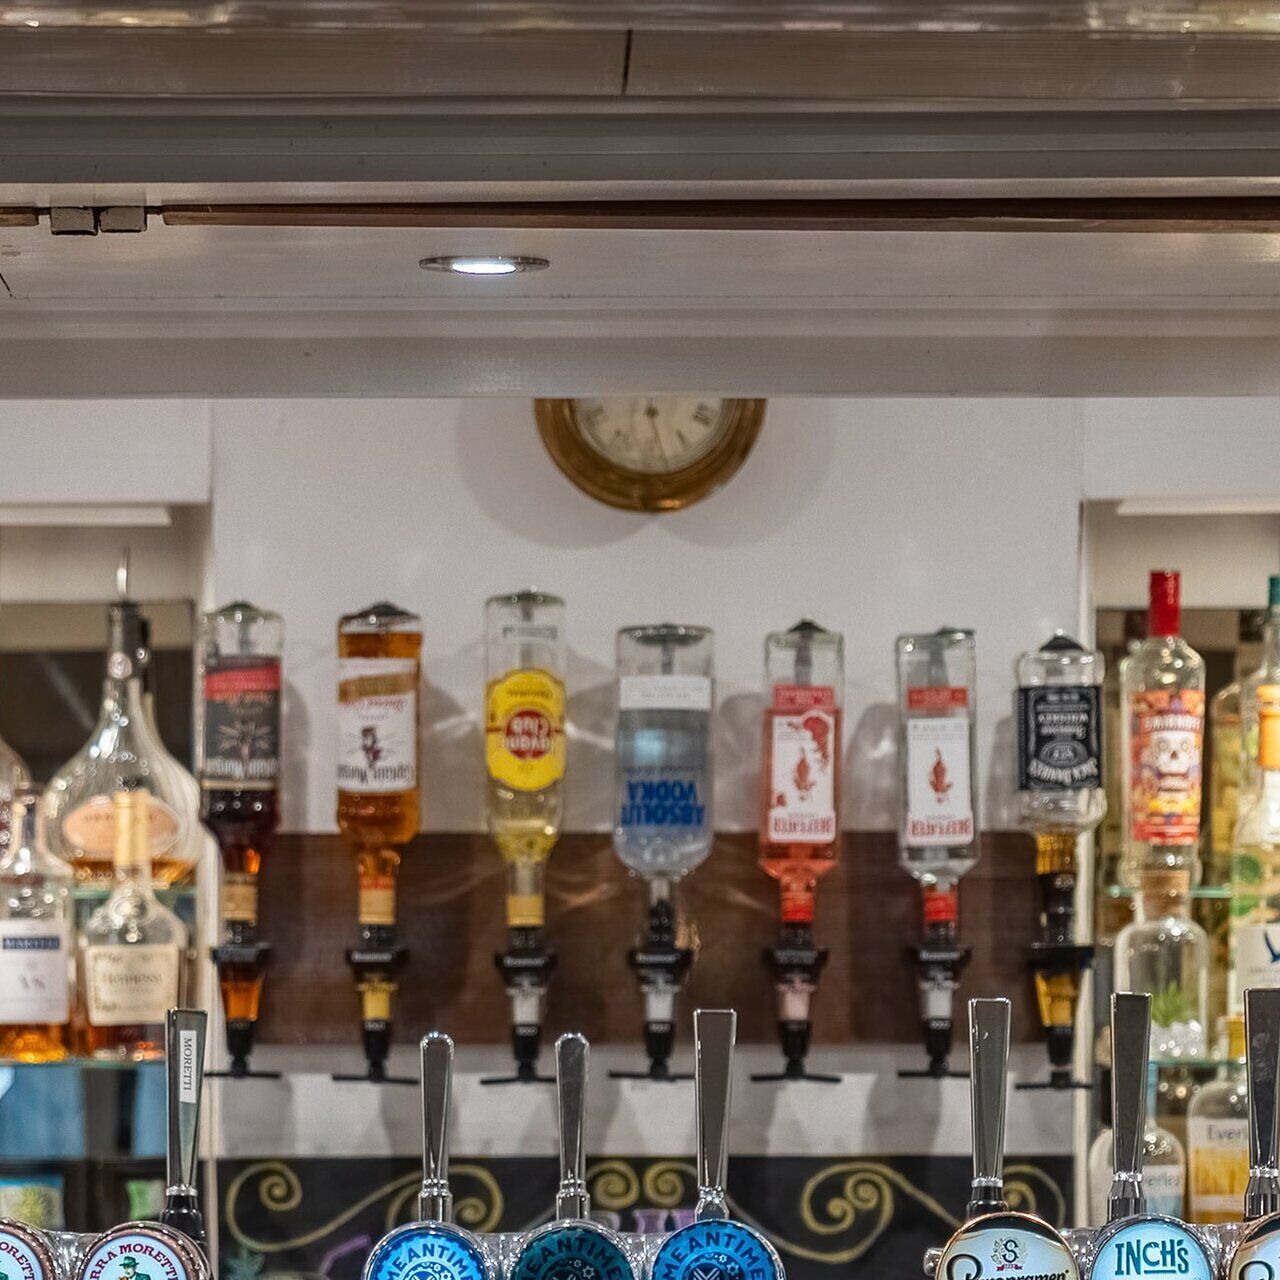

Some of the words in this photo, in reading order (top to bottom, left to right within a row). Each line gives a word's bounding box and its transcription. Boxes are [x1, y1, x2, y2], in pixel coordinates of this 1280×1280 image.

[626, 781, 697, 803] VODKA
[620, 804, 705, 828] ABSOLUT
[182, 1037, 193, 1091] MORETTI
